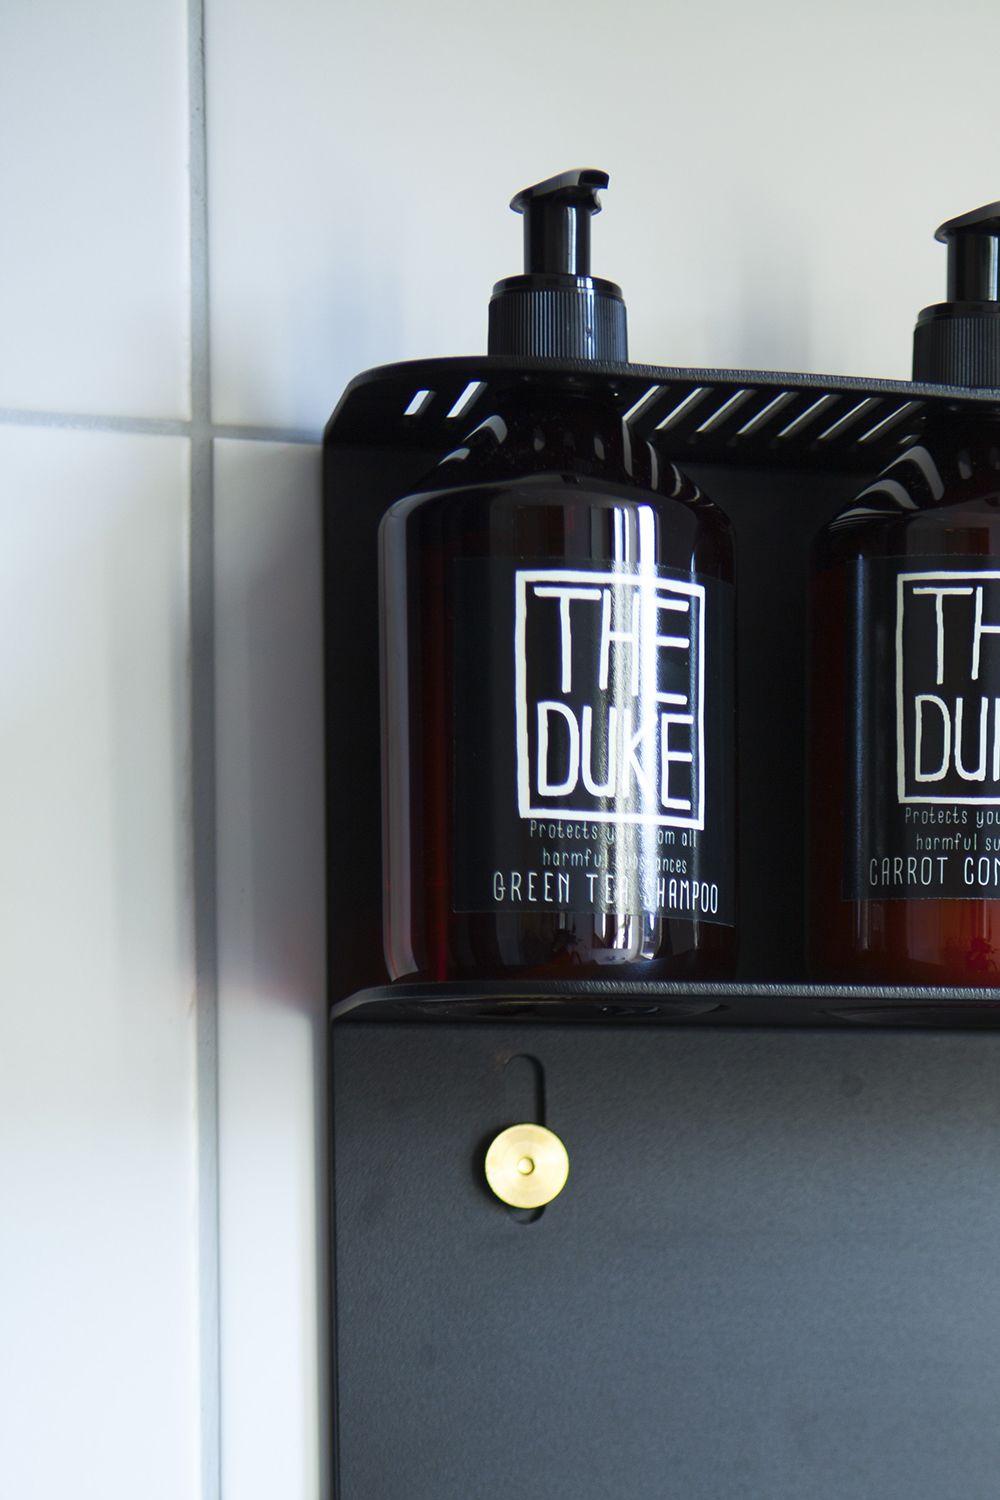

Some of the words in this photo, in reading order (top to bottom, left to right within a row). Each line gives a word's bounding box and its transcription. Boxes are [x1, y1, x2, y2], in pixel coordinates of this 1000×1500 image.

[534, 587, 690, 706] THE
[537, 701, 694, 812] DUKE
[904, 807, 968, 825] Protects
[530, 819, 599, 841] Protects
[681, 829, 697, 848] all
[915, 832, 977, 851] harmful
[542, 848, 609, 869] harmful
[869, 857, 949, 886] CARROT
[493, 871, 571, 904] GREEN
